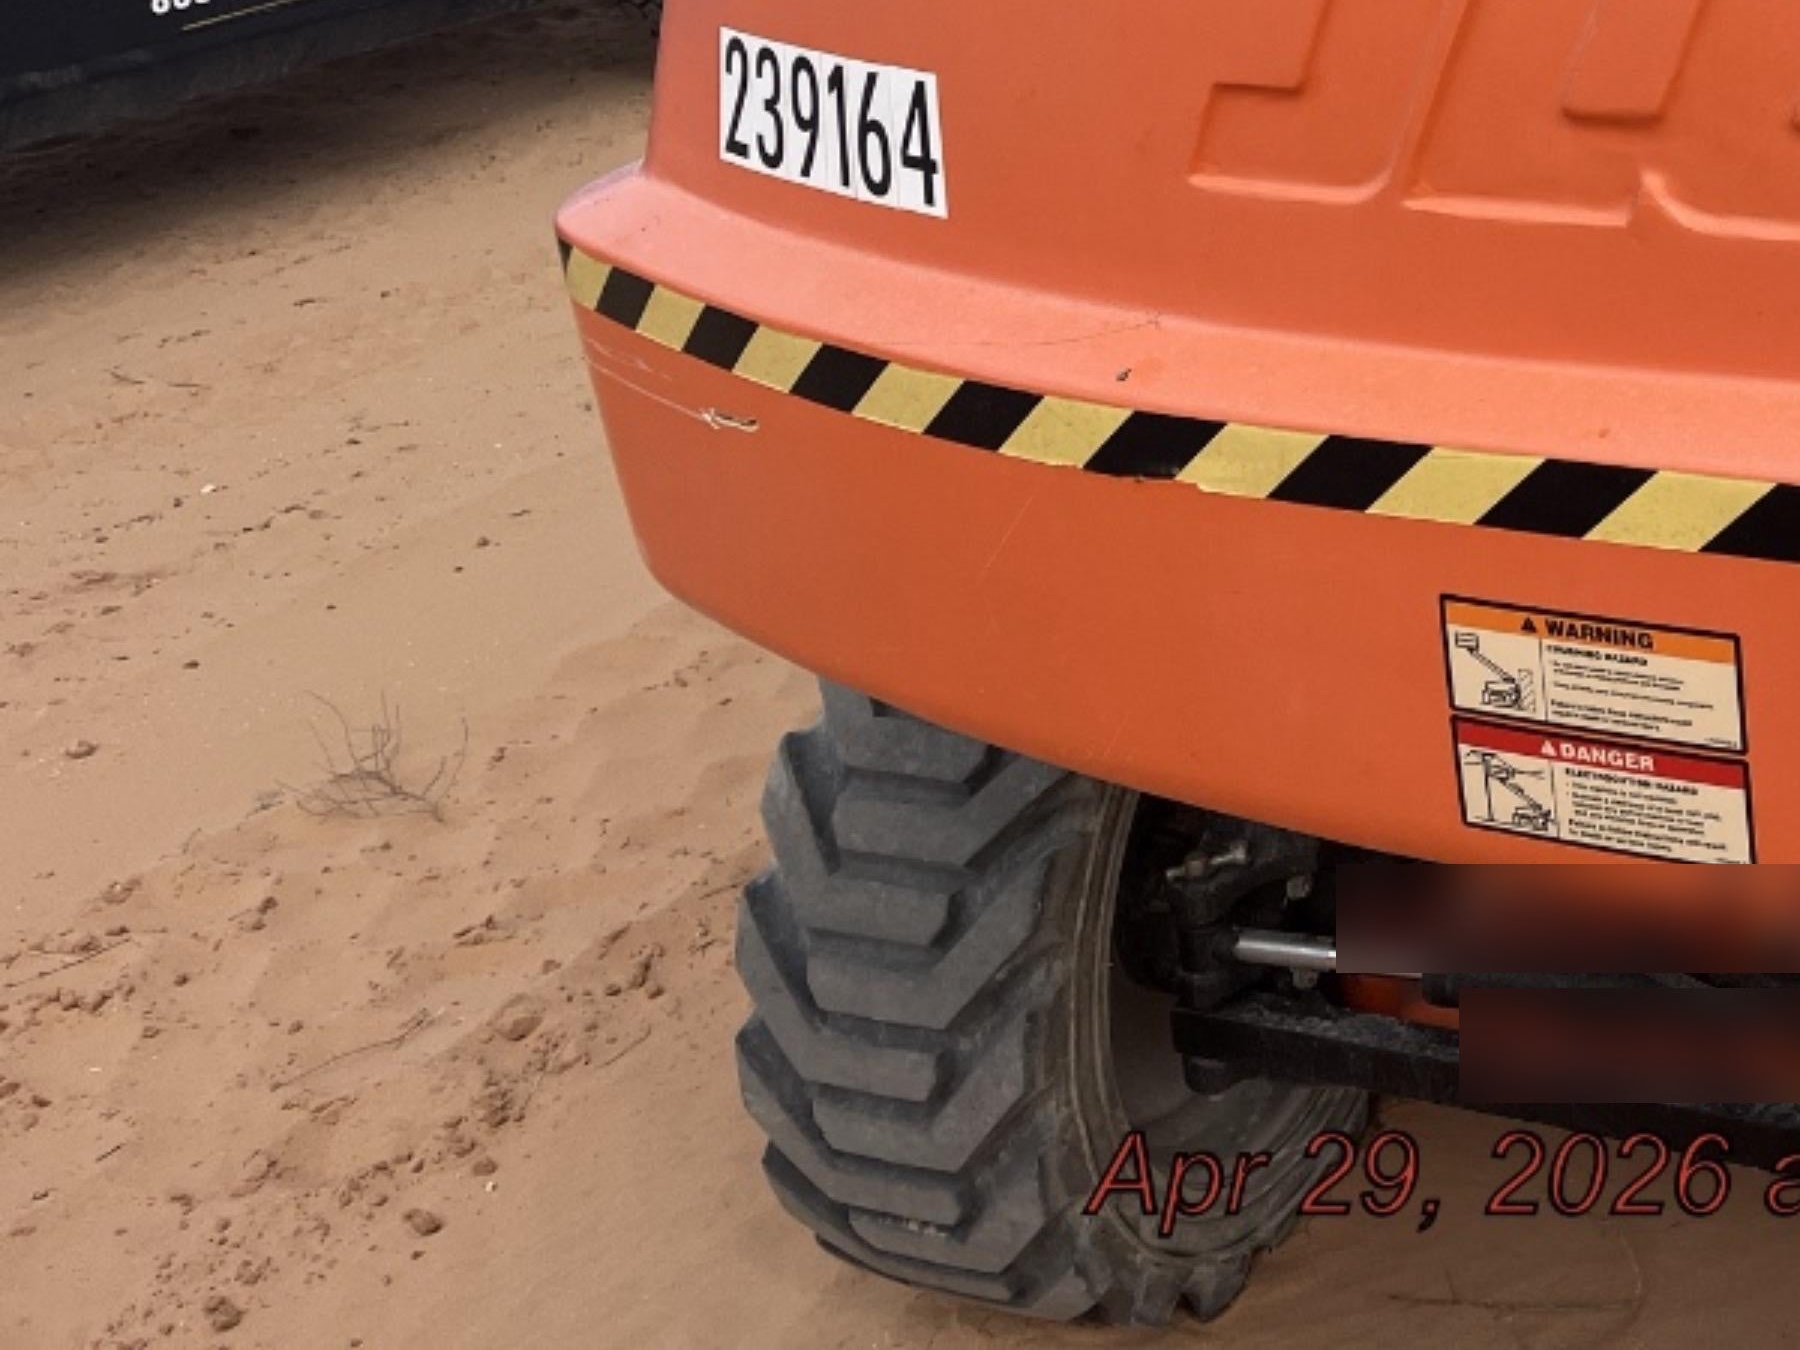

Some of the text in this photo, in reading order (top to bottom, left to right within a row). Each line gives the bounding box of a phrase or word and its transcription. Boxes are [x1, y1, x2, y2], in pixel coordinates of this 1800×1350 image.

[725, 36, 939, 208] 239164
[1545, 618, 1654, 651] WARNING
[1559, 742, 1655, 772] DANGER
